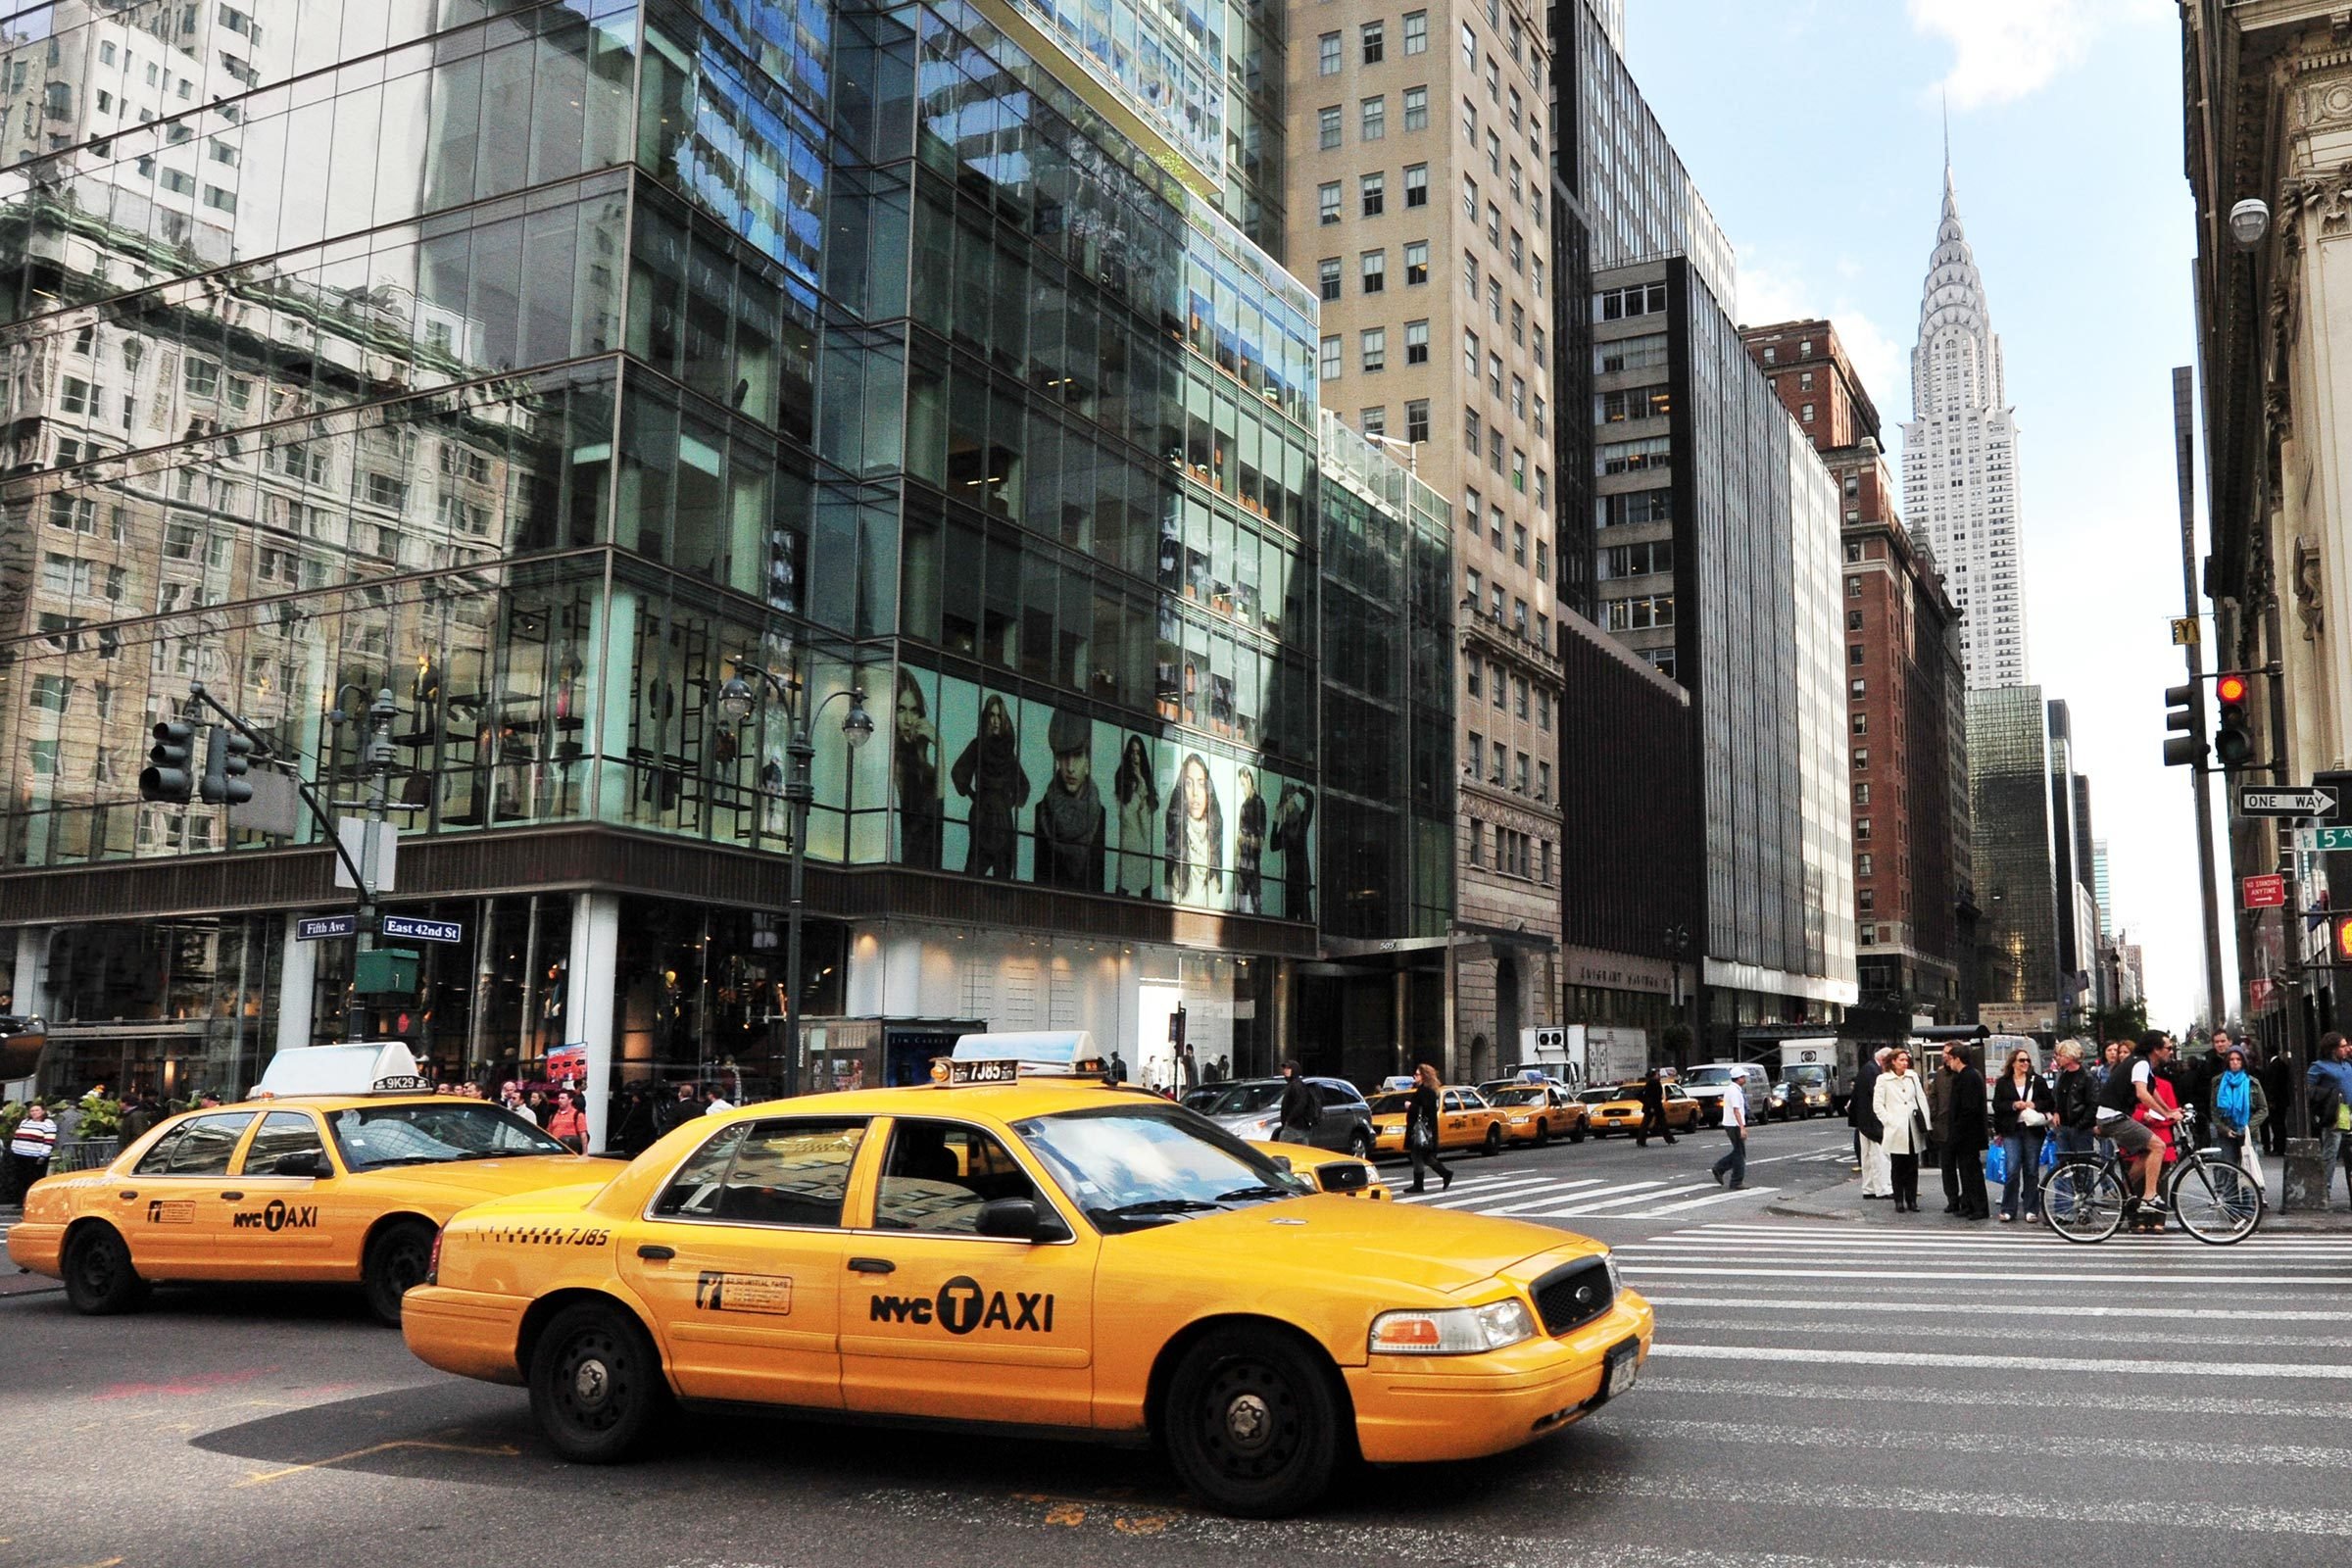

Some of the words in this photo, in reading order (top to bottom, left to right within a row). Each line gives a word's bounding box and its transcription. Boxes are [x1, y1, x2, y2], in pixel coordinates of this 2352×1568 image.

[2248, 795, 2278, 808] ONE
[2295, 796, 2325, 808] WAY
[2324, 830, 2336, 848] 5
[2256, 878, 2280, 888] STANDING
[307, 922, 327, 935] Fifth
[328, 921, 345, 933] Ave
[387, 921, 413, 934] East
[416, 924, 443, 937] 42nd
[444, 927, 457, 939] St
[970, 1061, 1001, 1081] 7J85
[386, 1077, 415, 1089] 9K29
[233, 1212, 263, 1228] NYC
[565, 1228, 612, 1246] 7J85
[870, 1294, 933, 1325] NYC
[941, 1280, 1054, 1333] TAXI
